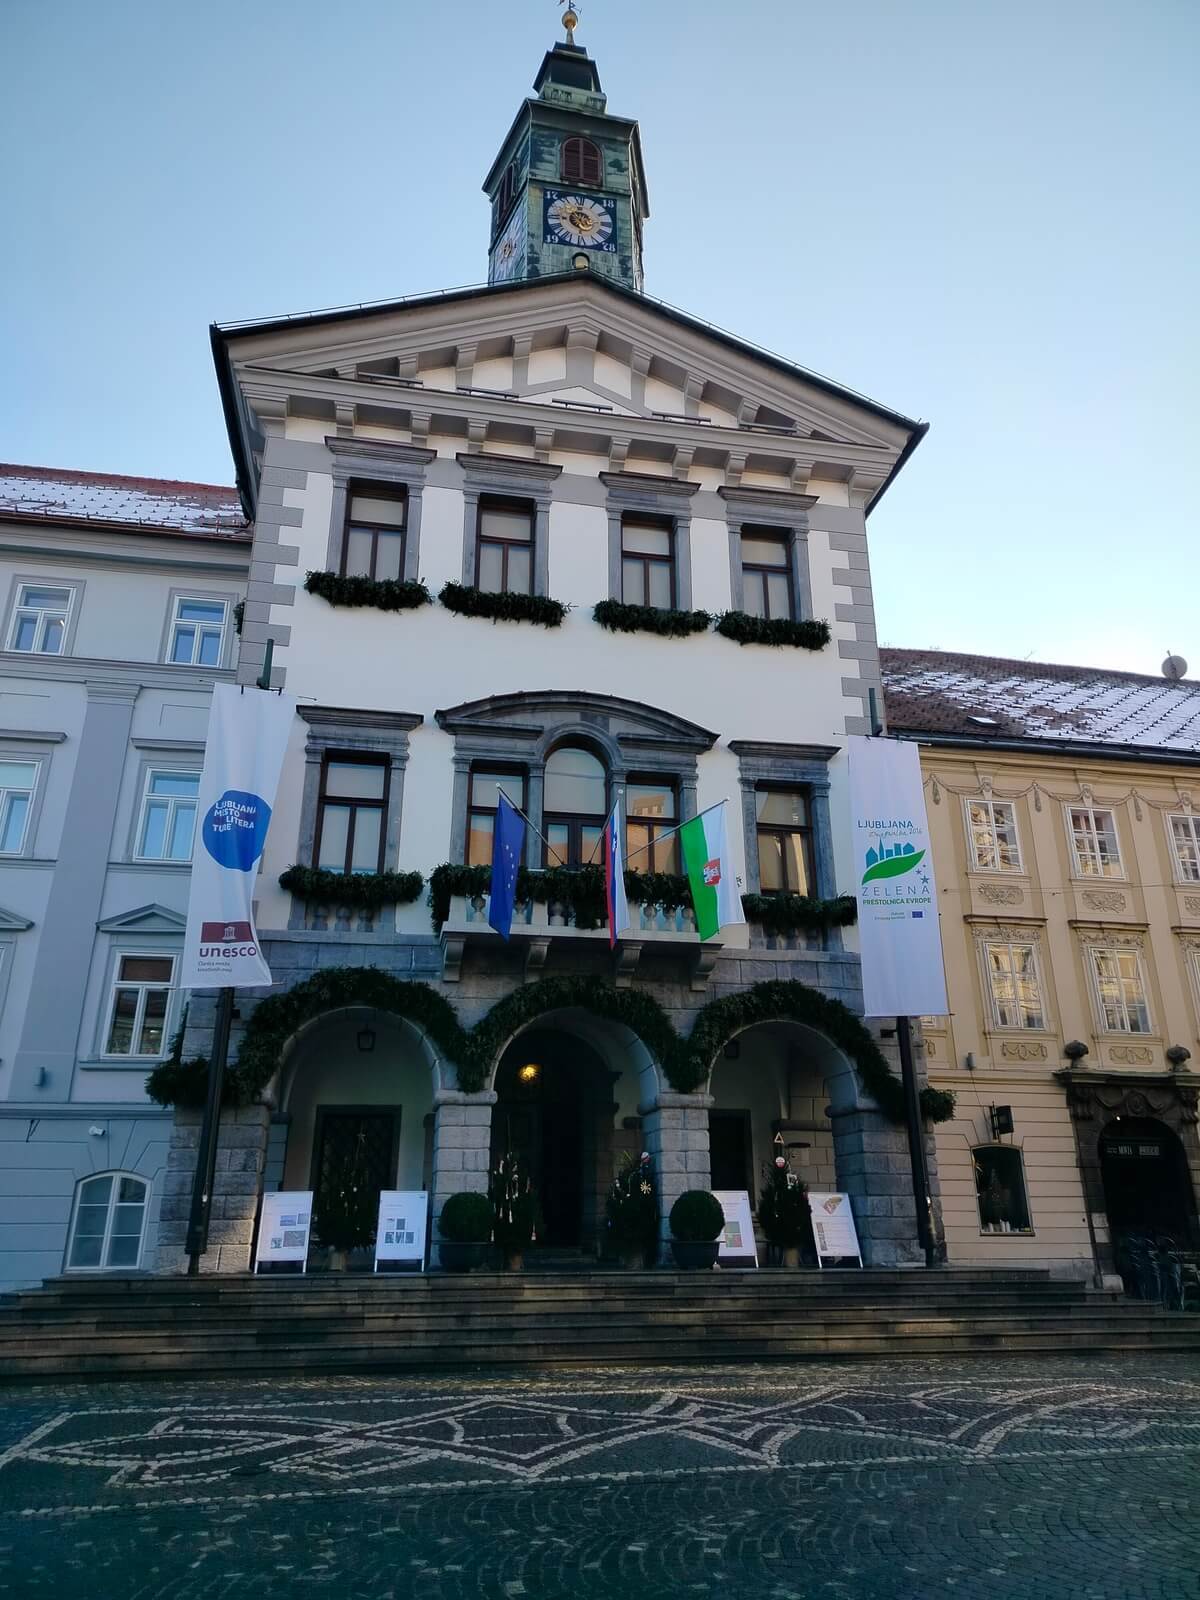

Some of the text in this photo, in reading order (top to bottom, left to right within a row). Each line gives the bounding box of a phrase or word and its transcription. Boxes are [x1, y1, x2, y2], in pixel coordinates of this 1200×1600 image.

[226, 816, 255, 829] LITERA
[857, 819, 914, 829] LJUBLJANA
[862, 885, 930, 896] ZELENA
[199, 946, 257, 958] unesco
